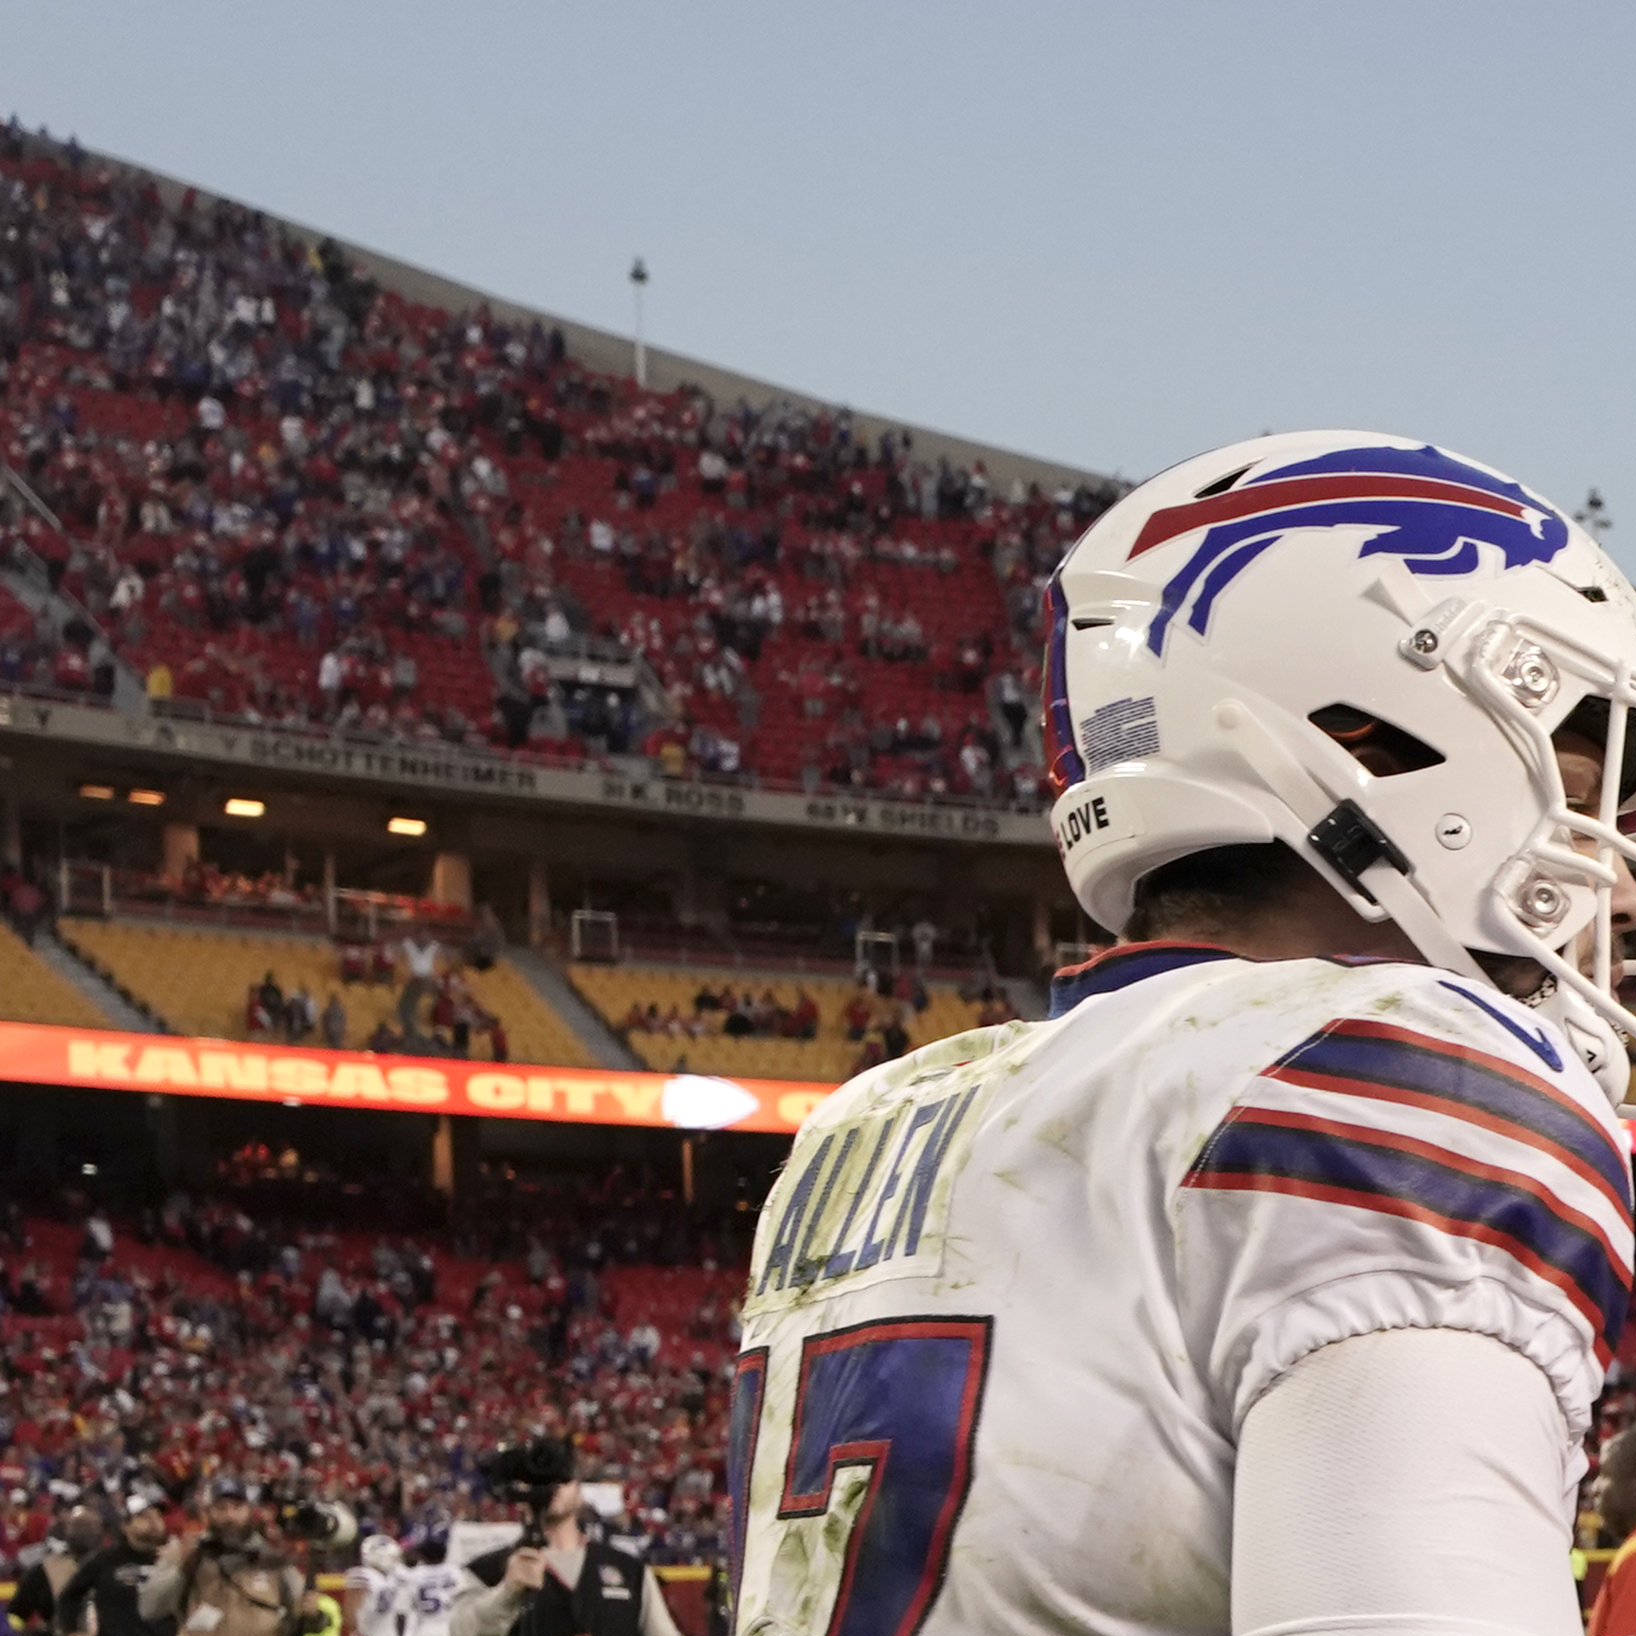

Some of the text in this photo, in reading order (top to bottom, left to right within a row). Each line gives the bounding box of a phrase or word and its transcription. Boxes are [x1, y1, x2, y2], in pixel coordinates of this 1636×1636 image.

[664, 787, 745, 814] ROSS
[1061, 796, 1110, 850] LOVE
[67, 1040, 663, 1121] KANSAS CITY
[756, 1083, 982, 1296] ALLEN
